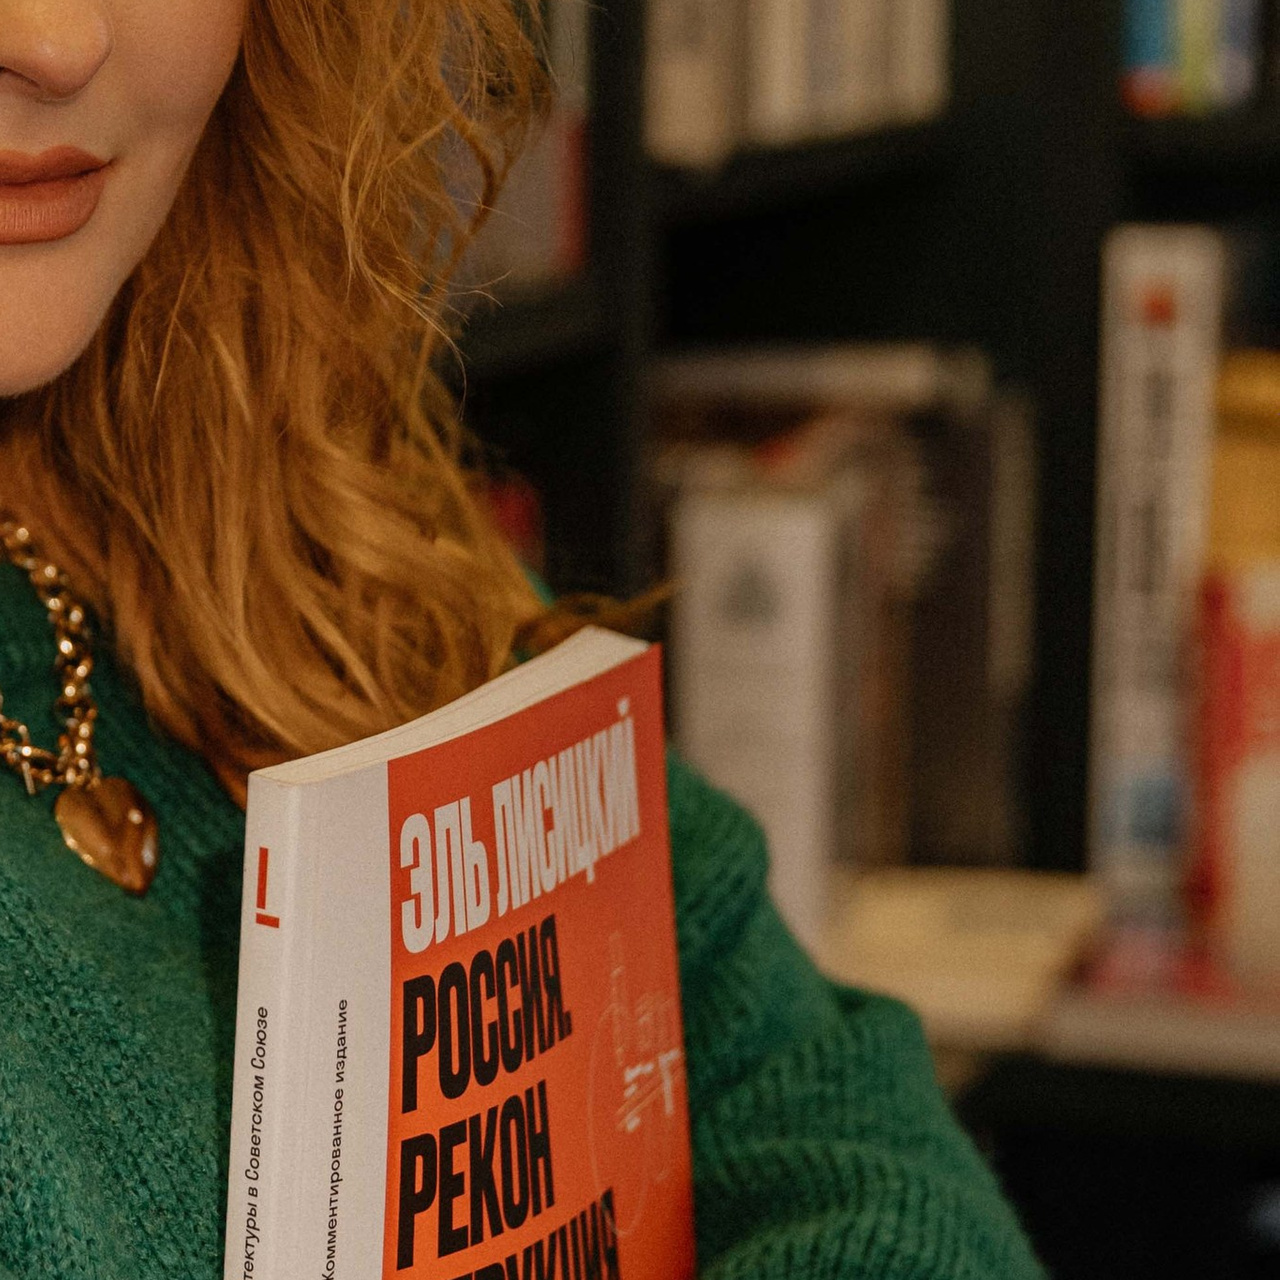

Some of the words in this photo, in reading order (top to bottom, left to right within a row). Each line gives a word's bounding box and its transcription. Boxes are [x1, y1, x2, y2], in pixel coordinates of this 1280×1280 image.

[400, 796, 491, 954] ЭЛЬ
[492, 697, 640, 918] ЛИСИЦКИЙ
[251, 1006, 268, 1069] Союзе
[336, 999, 348, 1082] издание
[402, 913, 573, 1114] РОССИЯ.
[245, 1075, 265, 1181] Советском
[396, 1079, 555, 1271] РЕКОН
[247, 1186, 258, 1199] в
